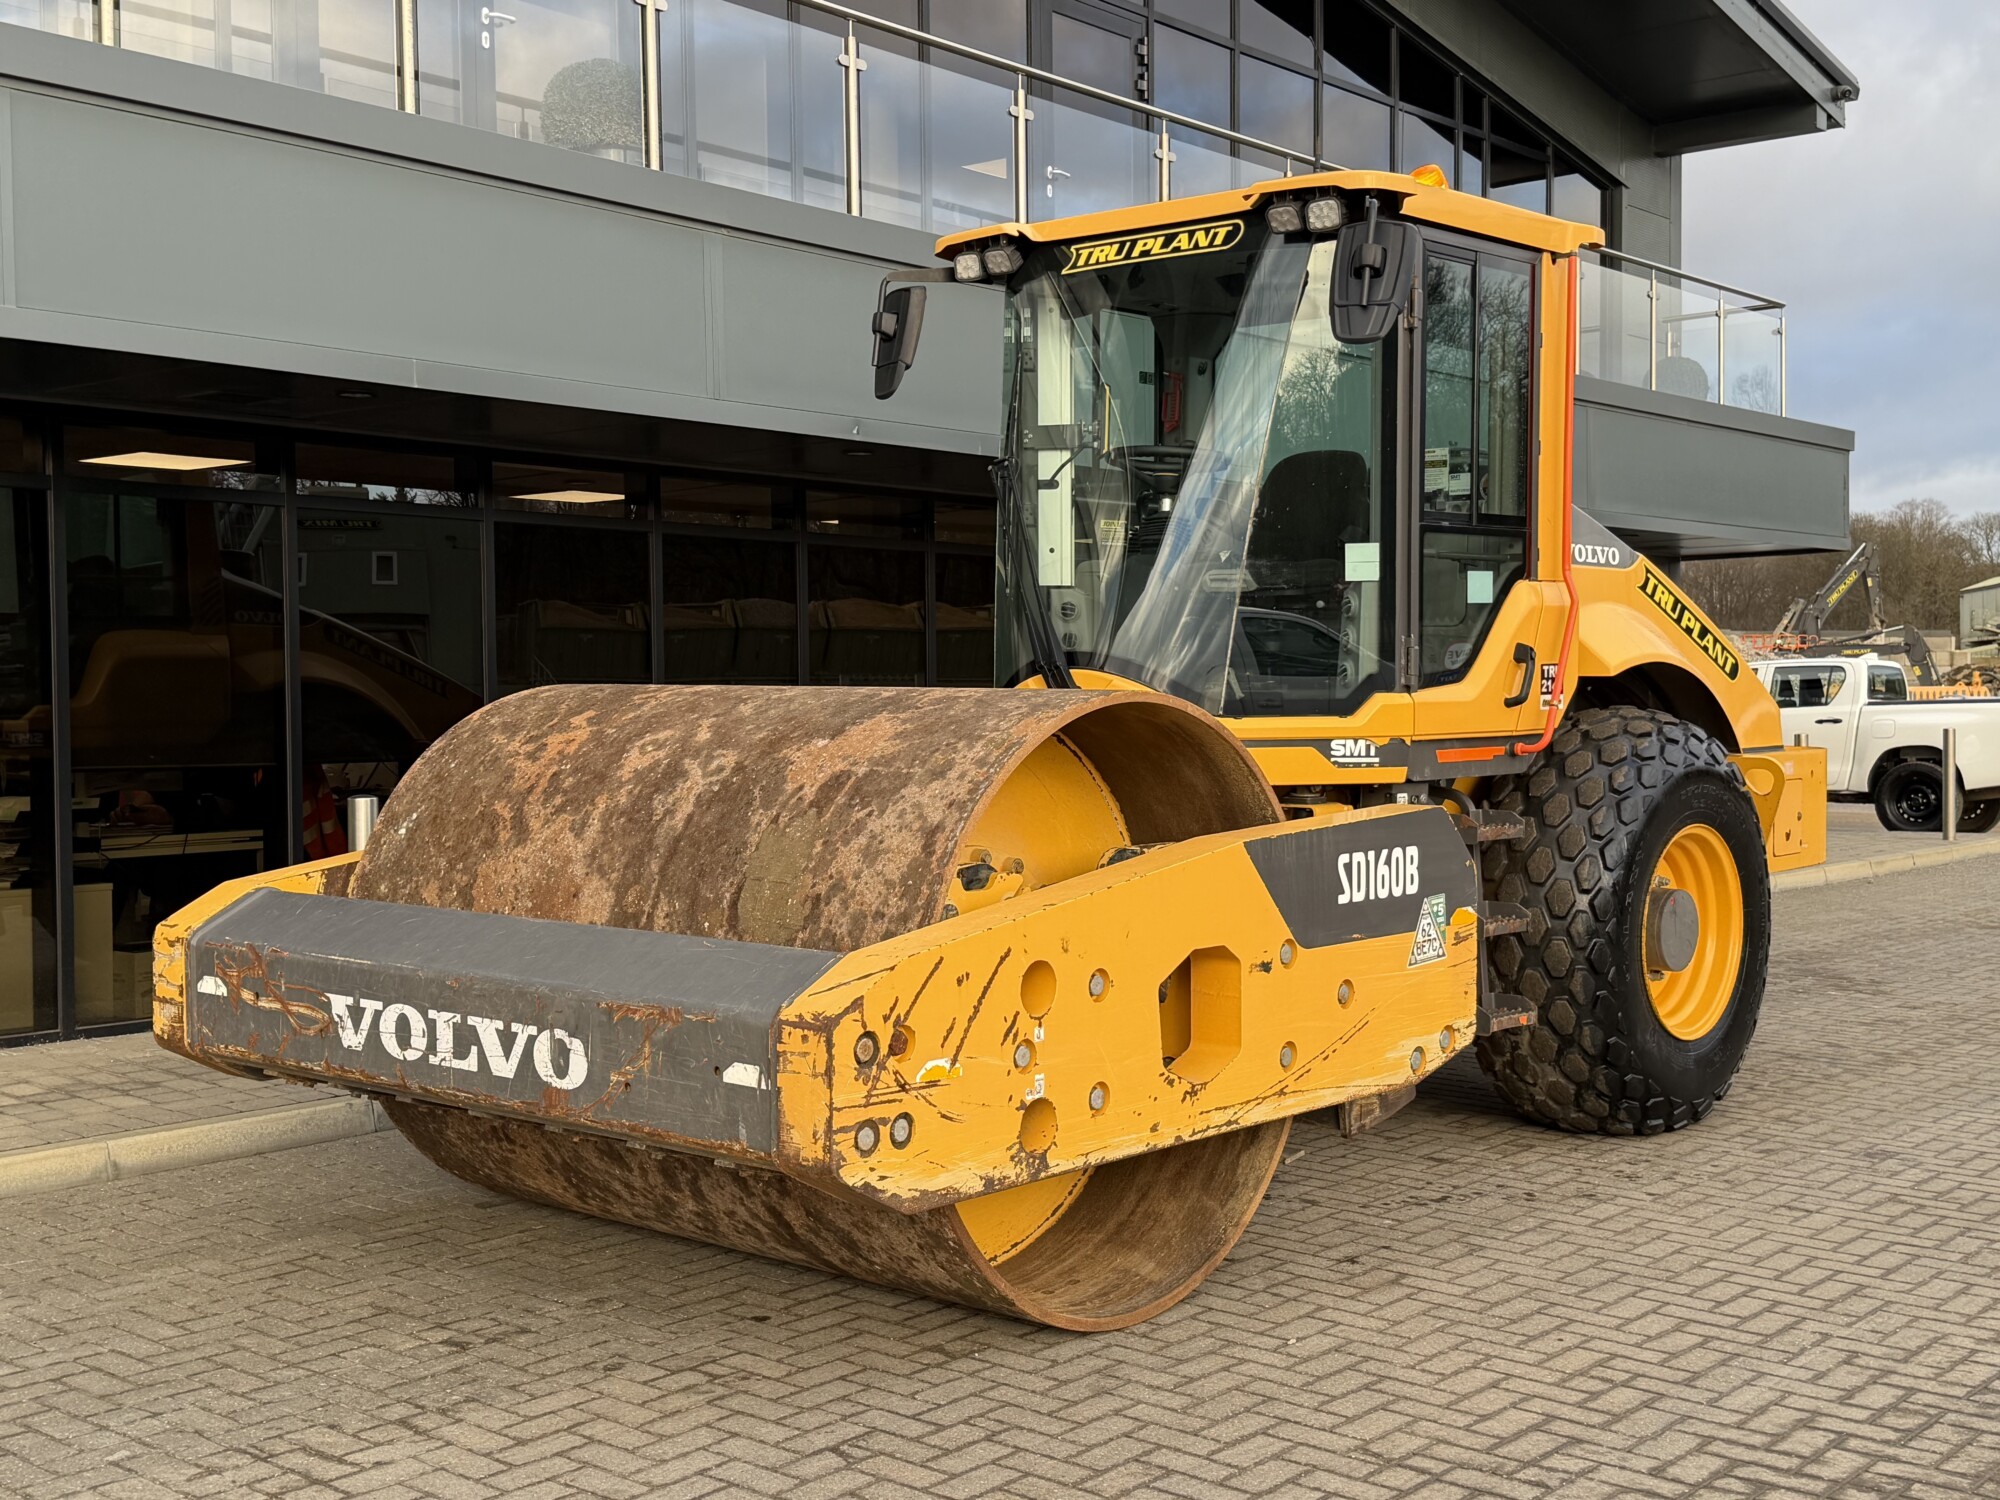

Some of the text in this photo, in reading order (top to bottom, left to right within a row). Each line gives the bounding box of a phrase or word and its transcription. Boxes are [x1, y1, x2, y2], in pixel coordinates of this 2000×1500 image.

[1076, 226, 1234, 267] TRU PLANT
[1645, 573, 1736, 674] TRU PLANT
[1330, 739, 1379, 757] SMT
[1337, 845, 1419, 905] SD160B
[1421, 922, 1432, 938] 62
[325, 993, 588, 1090] VOLVO
